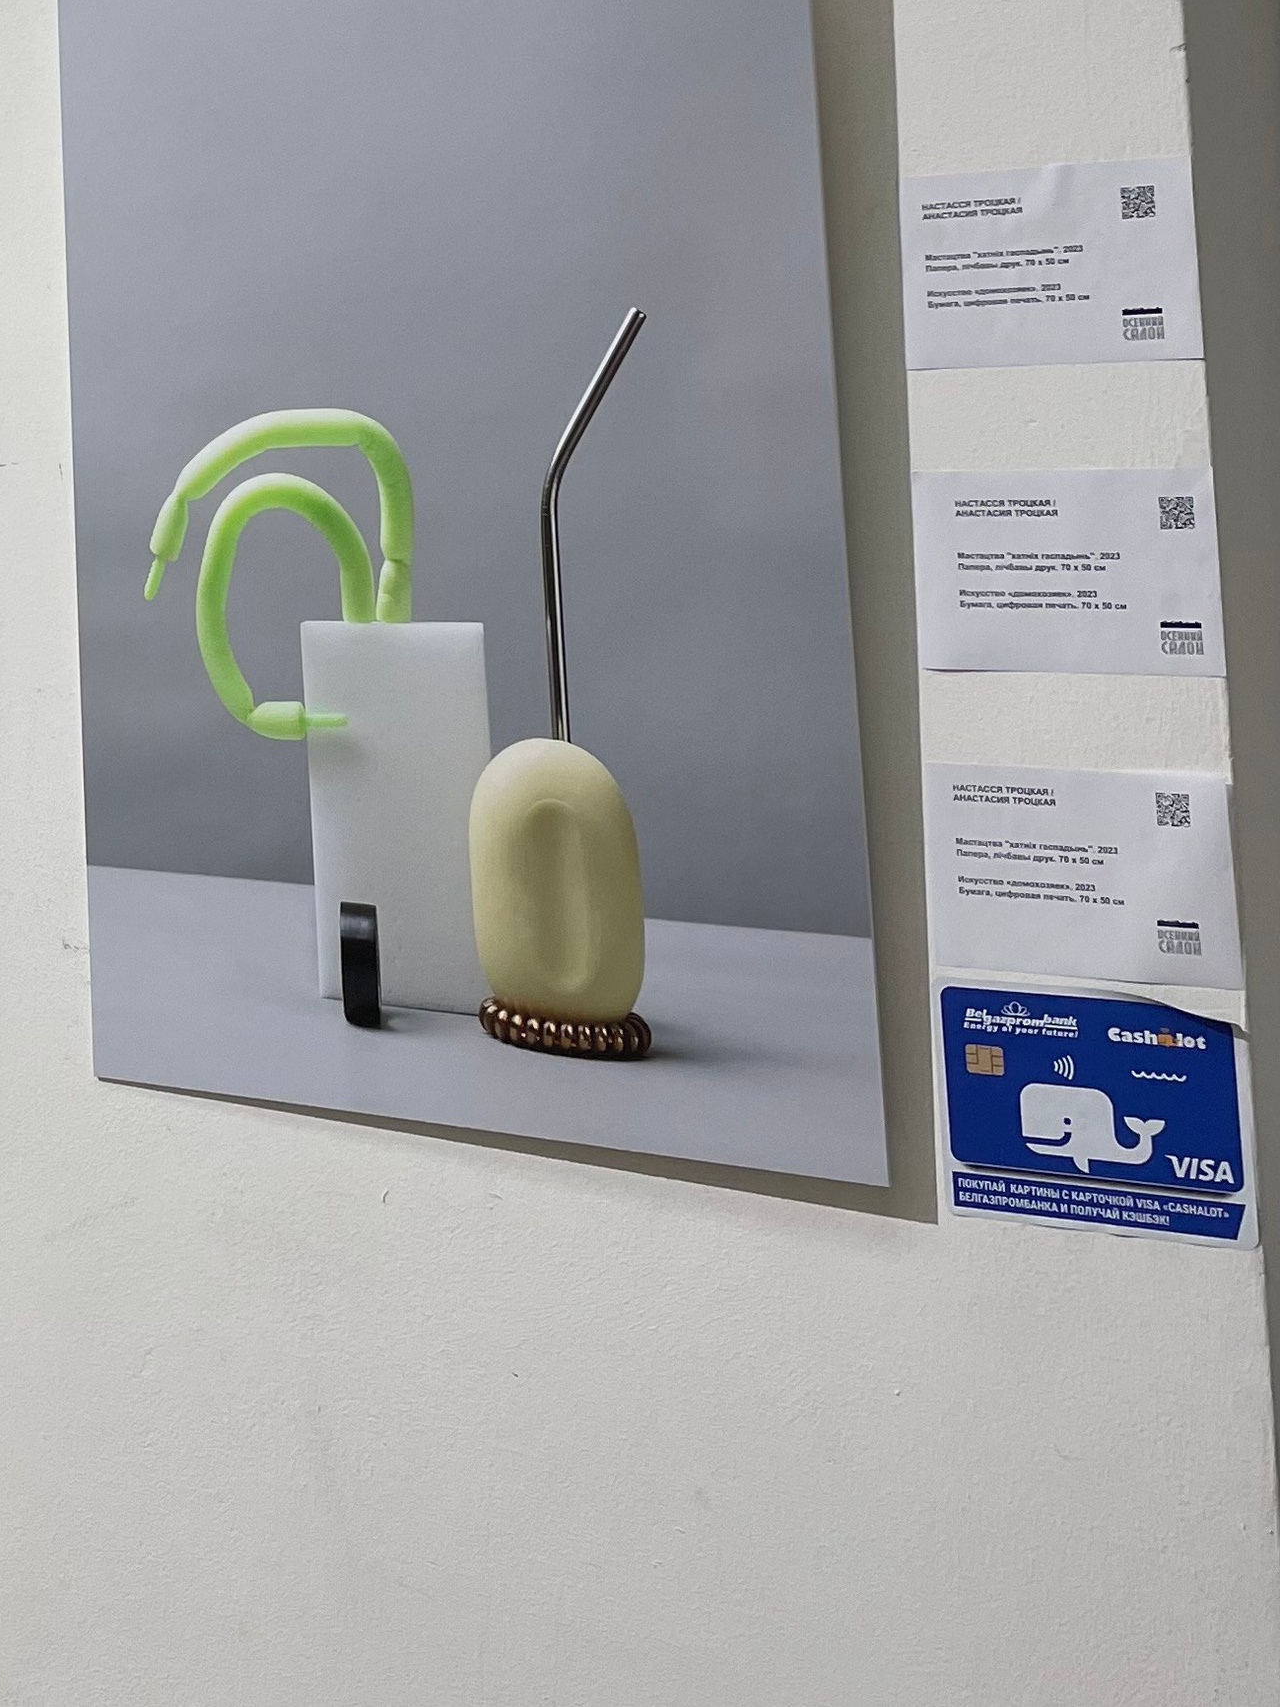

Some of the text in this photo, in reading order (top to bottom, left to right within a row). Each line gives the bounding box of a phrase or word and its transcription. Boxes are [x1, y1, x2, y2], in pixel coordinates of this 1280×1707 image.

[1007, 499, 1051, 508] ТРОЦКАЯ
[955, 509, 1059, 518] АНАСТАСИЯ ТРОЦКАЯ
[952, 784, 1003, 794] НАСТАССЯ
[1005, 786, 1049, 796] ТРОЦКАЯ
[953, 794, 1056, 807] АНАСТАСИЯ ТРОЦКАЯ
[1059, 855, 1069, 863] 70
[1079, 895, 1090, 903] 70
[1100, 896, 1110, 904] 50
[965, 1008, 1078, 1027] Belgazprombank
[963, 1022, 1078, 1038] Energy of your future!
[1165, 1155, 1234, 1184] VISA
[958, 1177, 1229, 1218] ПОКУПАЙ КАРТИНЫ С КАРТОЧКОЙ VISA «CASHALOT»
[959, 1192, 1170, 1225] БЕЛГАЗПРОМБАНКА И ПОЛУЧАЙ КЭШБЭК!
